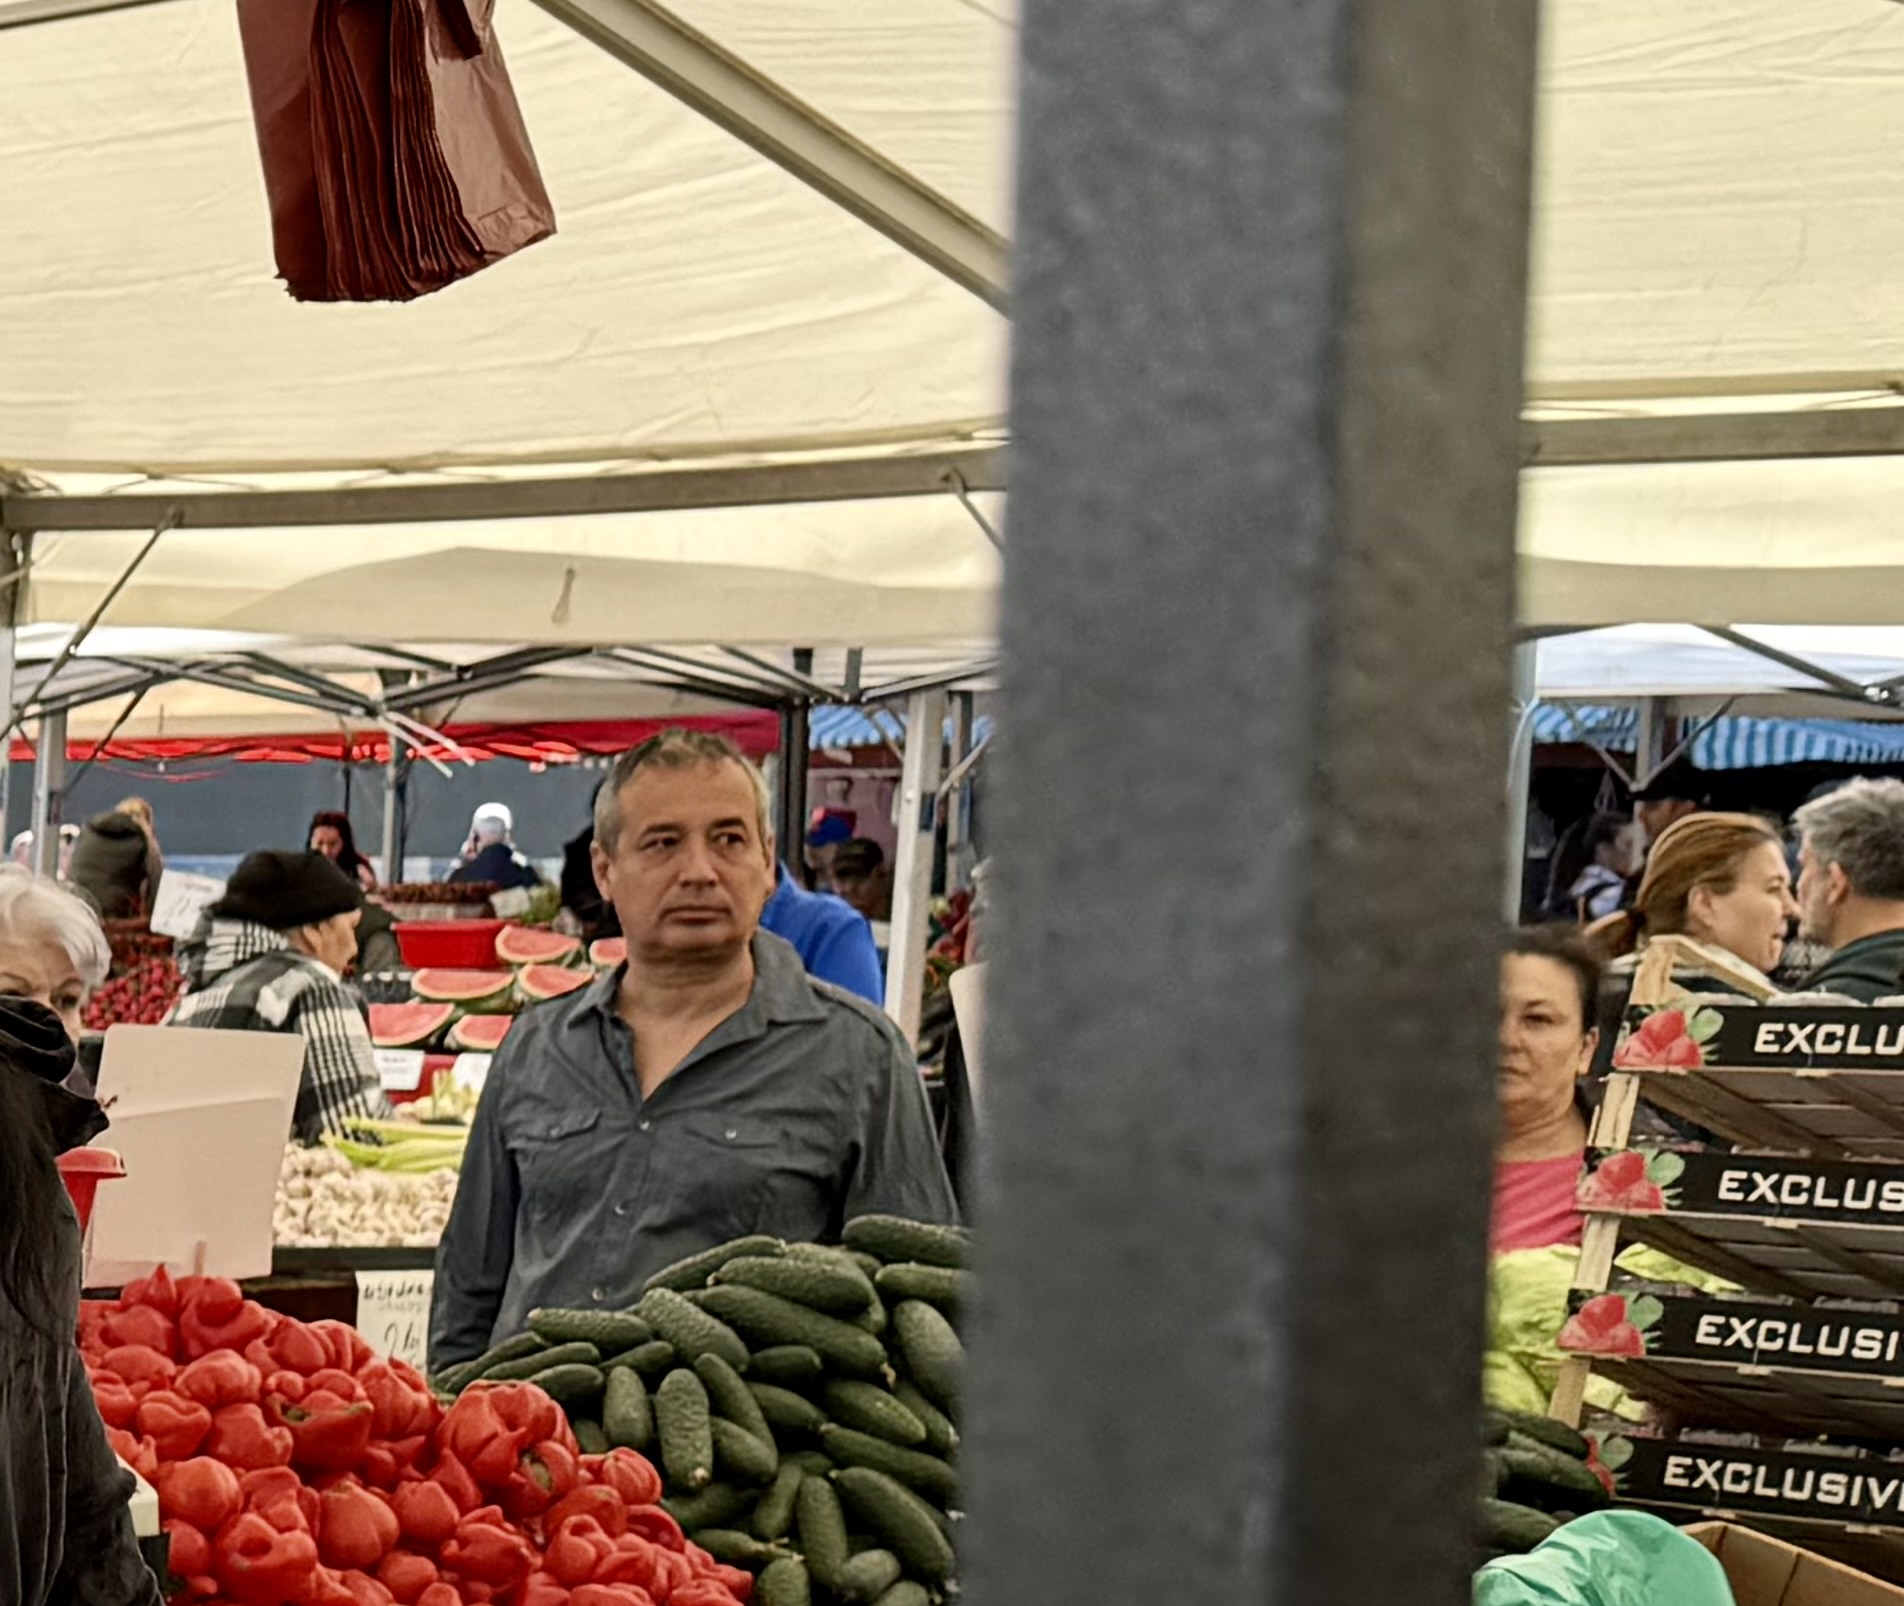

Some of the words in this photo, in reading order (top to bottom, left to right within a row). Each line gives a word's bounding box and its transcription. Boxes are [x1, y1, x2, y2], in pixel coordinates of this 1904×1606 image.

[1717, 1169, 1904, 1213] EXCLUS
[1693, 1313, 1899, 1361] EXCLUSI
[1663, 1455, 1904, 1512] EXCLUSIV
